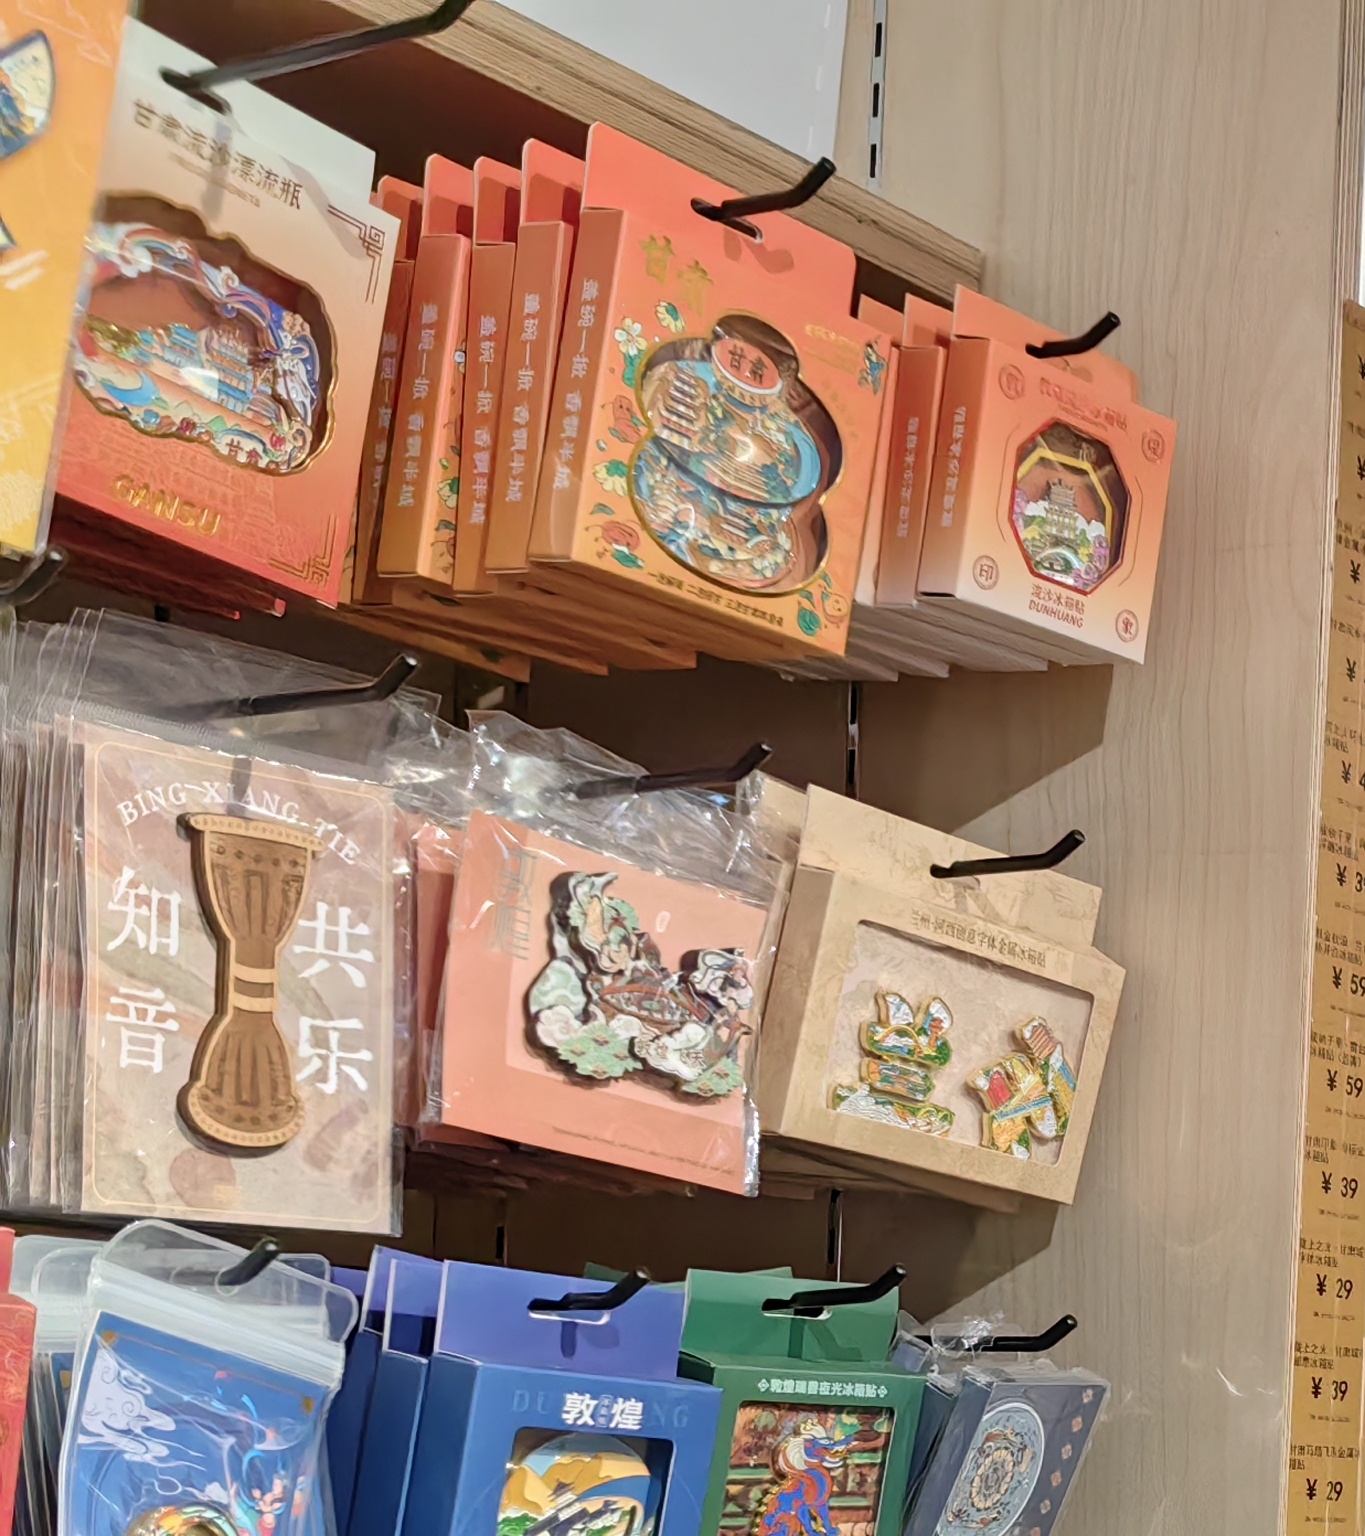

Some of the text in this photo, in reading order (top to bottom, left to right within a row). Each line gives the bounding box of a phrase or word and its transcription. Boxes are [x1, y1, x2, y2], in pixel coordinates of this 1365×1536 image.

[111, 474, 222, 538] GANSU
[1028, 599, 1085, 629] DUNHUANG
[1345, 1075, 1363, 1098] 59
[1340, 1177, 1358, 1199] 39
[1335, 1278, 1353, 1300] 29
[1331, 1380, 1348, 1402] 39
[561, 1391, 645, 1430] 敦煌
[1326, 1481, 1344, 1501] 29
